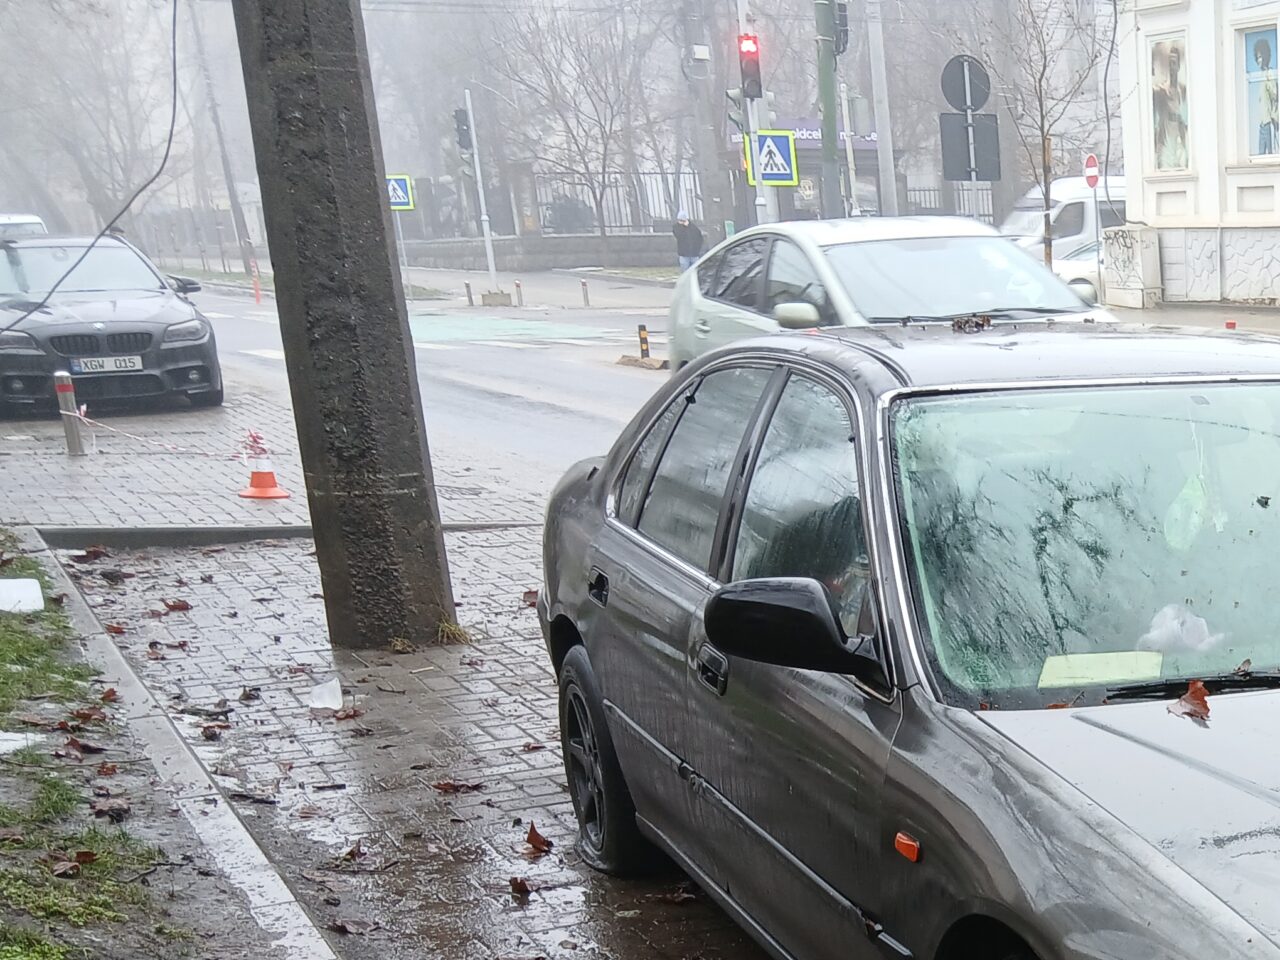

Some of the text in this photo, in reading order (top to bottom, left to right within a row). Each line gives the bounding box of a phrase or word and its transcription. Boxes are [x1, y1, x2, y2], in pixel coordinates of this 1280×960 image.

[791, 128, 822, 140] oldcel
[82, 359, 105, 370] XGW
[113, 358, 136, 369] 015
